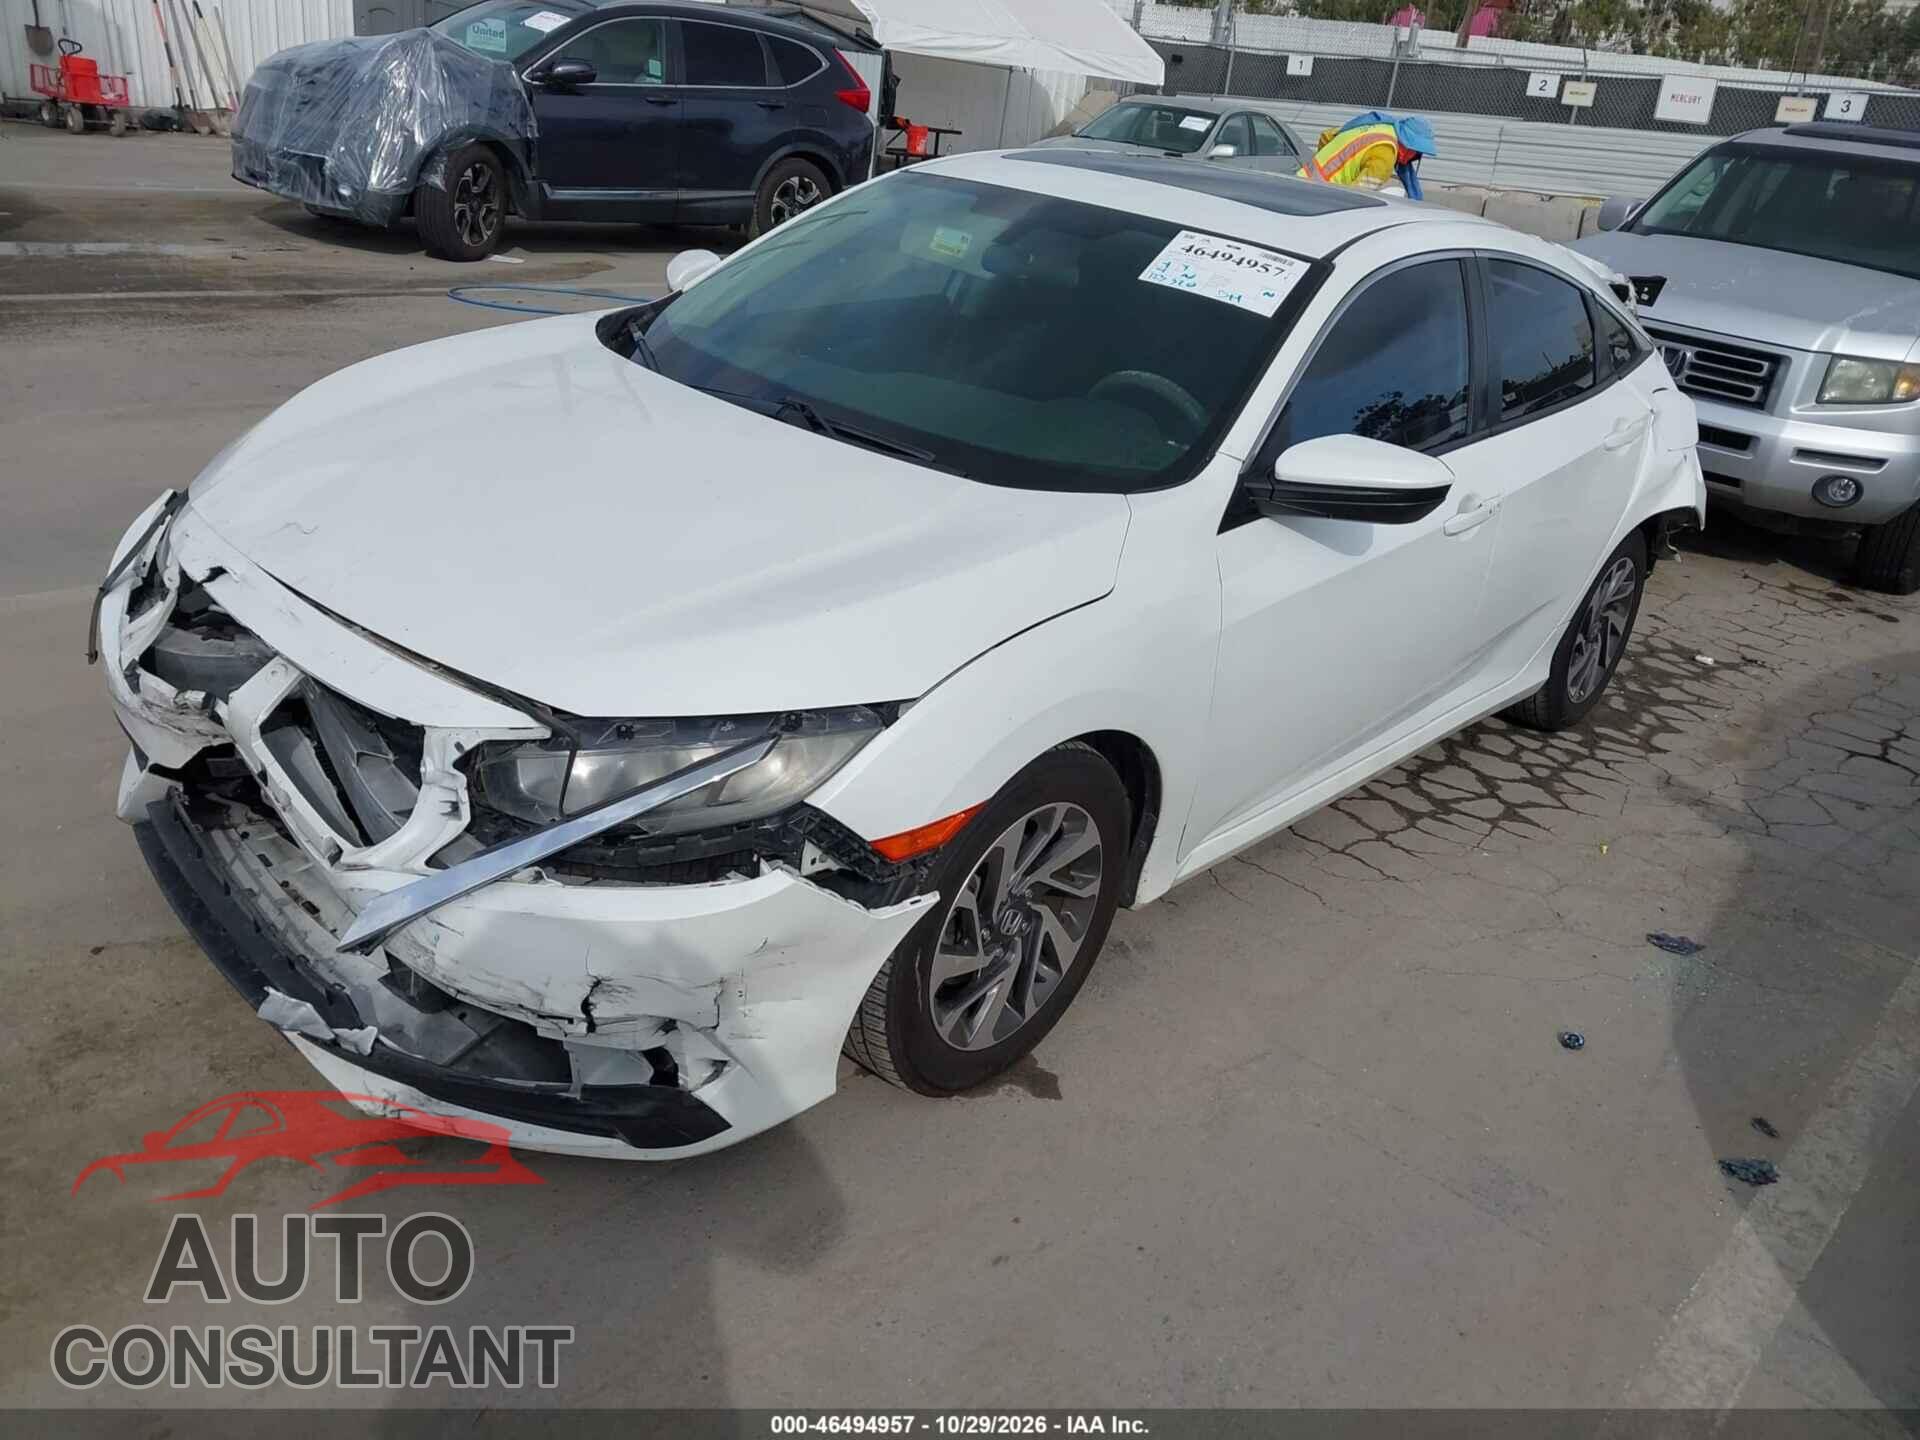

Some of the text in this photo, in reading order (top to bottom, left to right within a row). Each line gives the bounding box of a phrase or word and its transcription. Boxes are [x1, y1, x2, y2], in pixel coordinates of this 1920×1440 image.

[1538, 79, 1548, 92] 2
[1840, 99, 1852, 113] 3
[1181, 244, 1285, 277] 46494957
